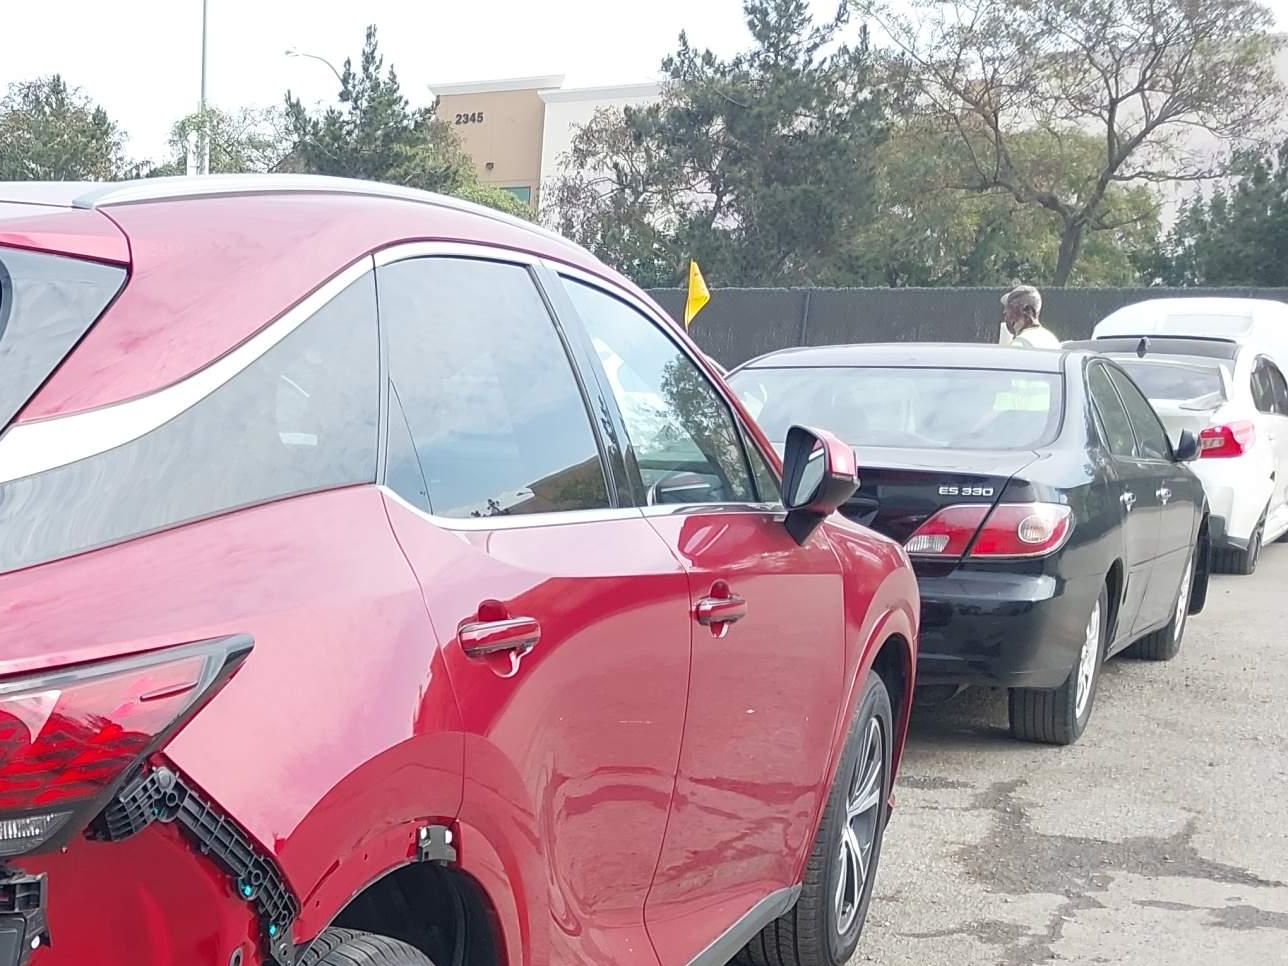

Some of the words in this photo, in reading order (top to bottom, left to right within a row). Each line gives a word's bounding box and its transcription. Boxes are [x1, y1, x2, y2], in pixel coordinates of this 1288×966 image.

[455, 112, 484, 125] 2345
[938, 486, 959, 496] ES
[961, 487, 994, 497] 330
